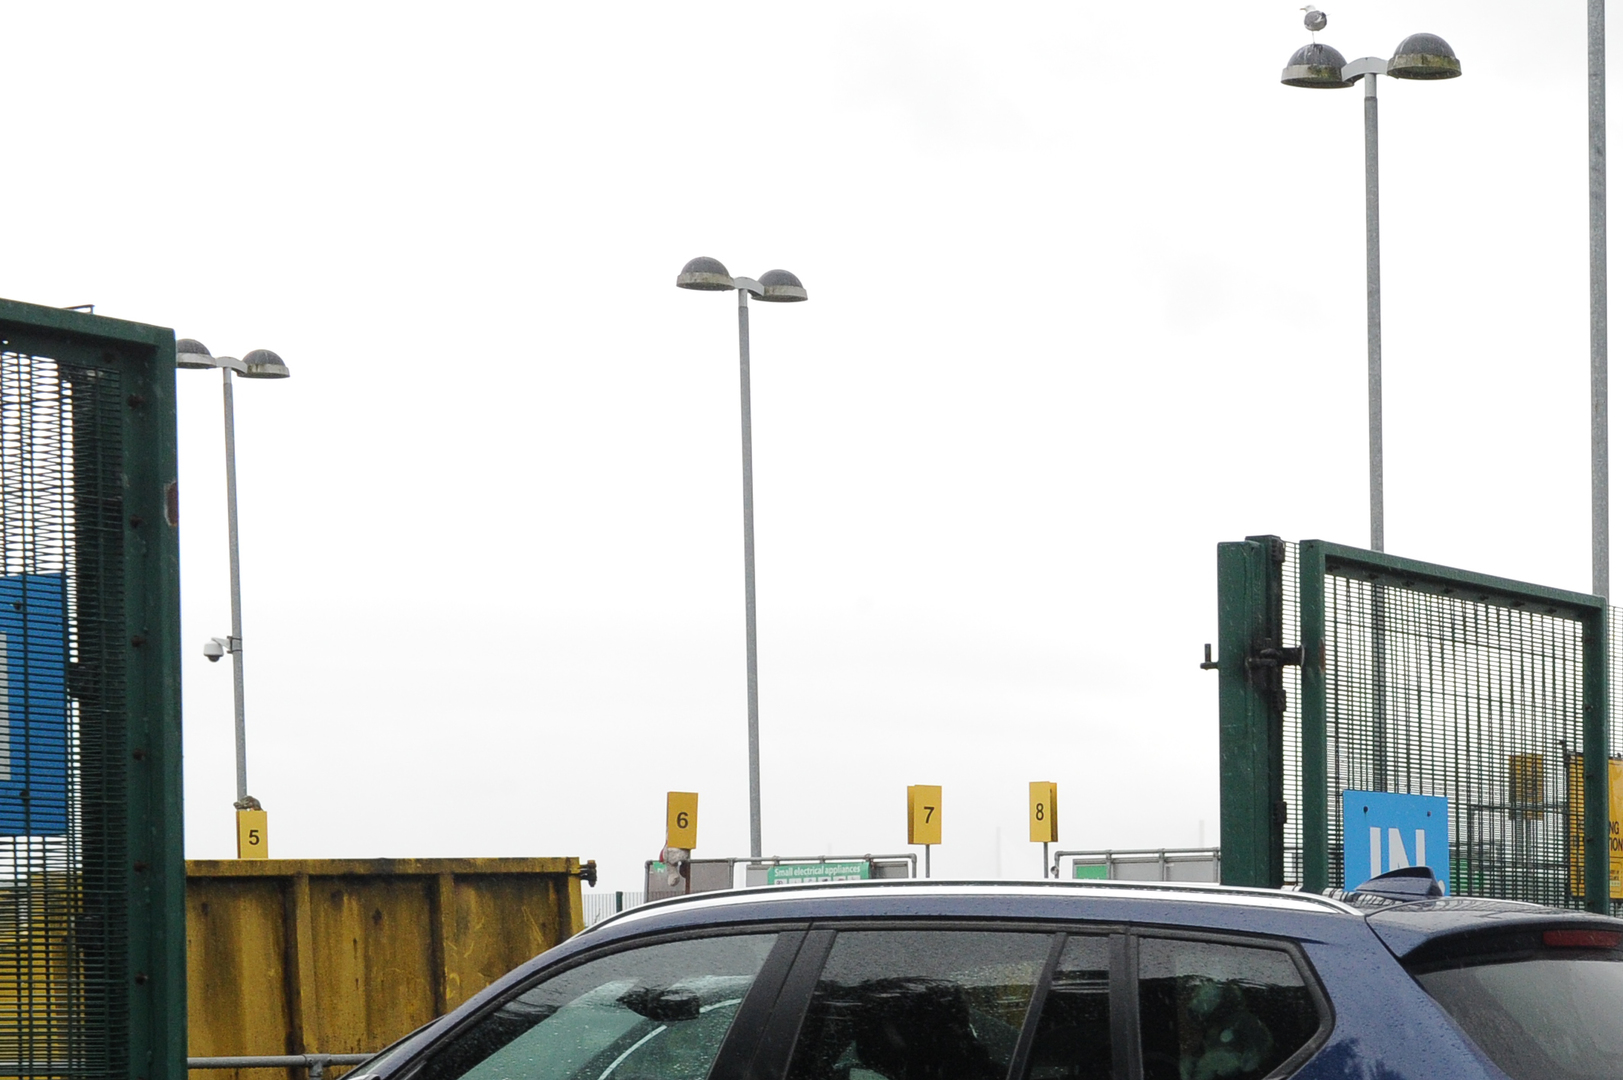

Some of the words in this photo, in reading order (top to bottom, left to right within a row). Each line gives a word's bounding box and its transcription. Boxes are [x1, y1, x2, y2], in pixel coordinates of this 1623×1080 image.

[676, 811, 688, 829] 6
[923, 806, 935, 823] 7
[1035, 802, 1045, 821] 8
[248, 829, 260, 846] 5
[1370, 826, 1426, 878] IN
[774, 867, 793, 877] Small
[794, 866, 824, 876] electrical
[824, 865, 861, 876] appliances
